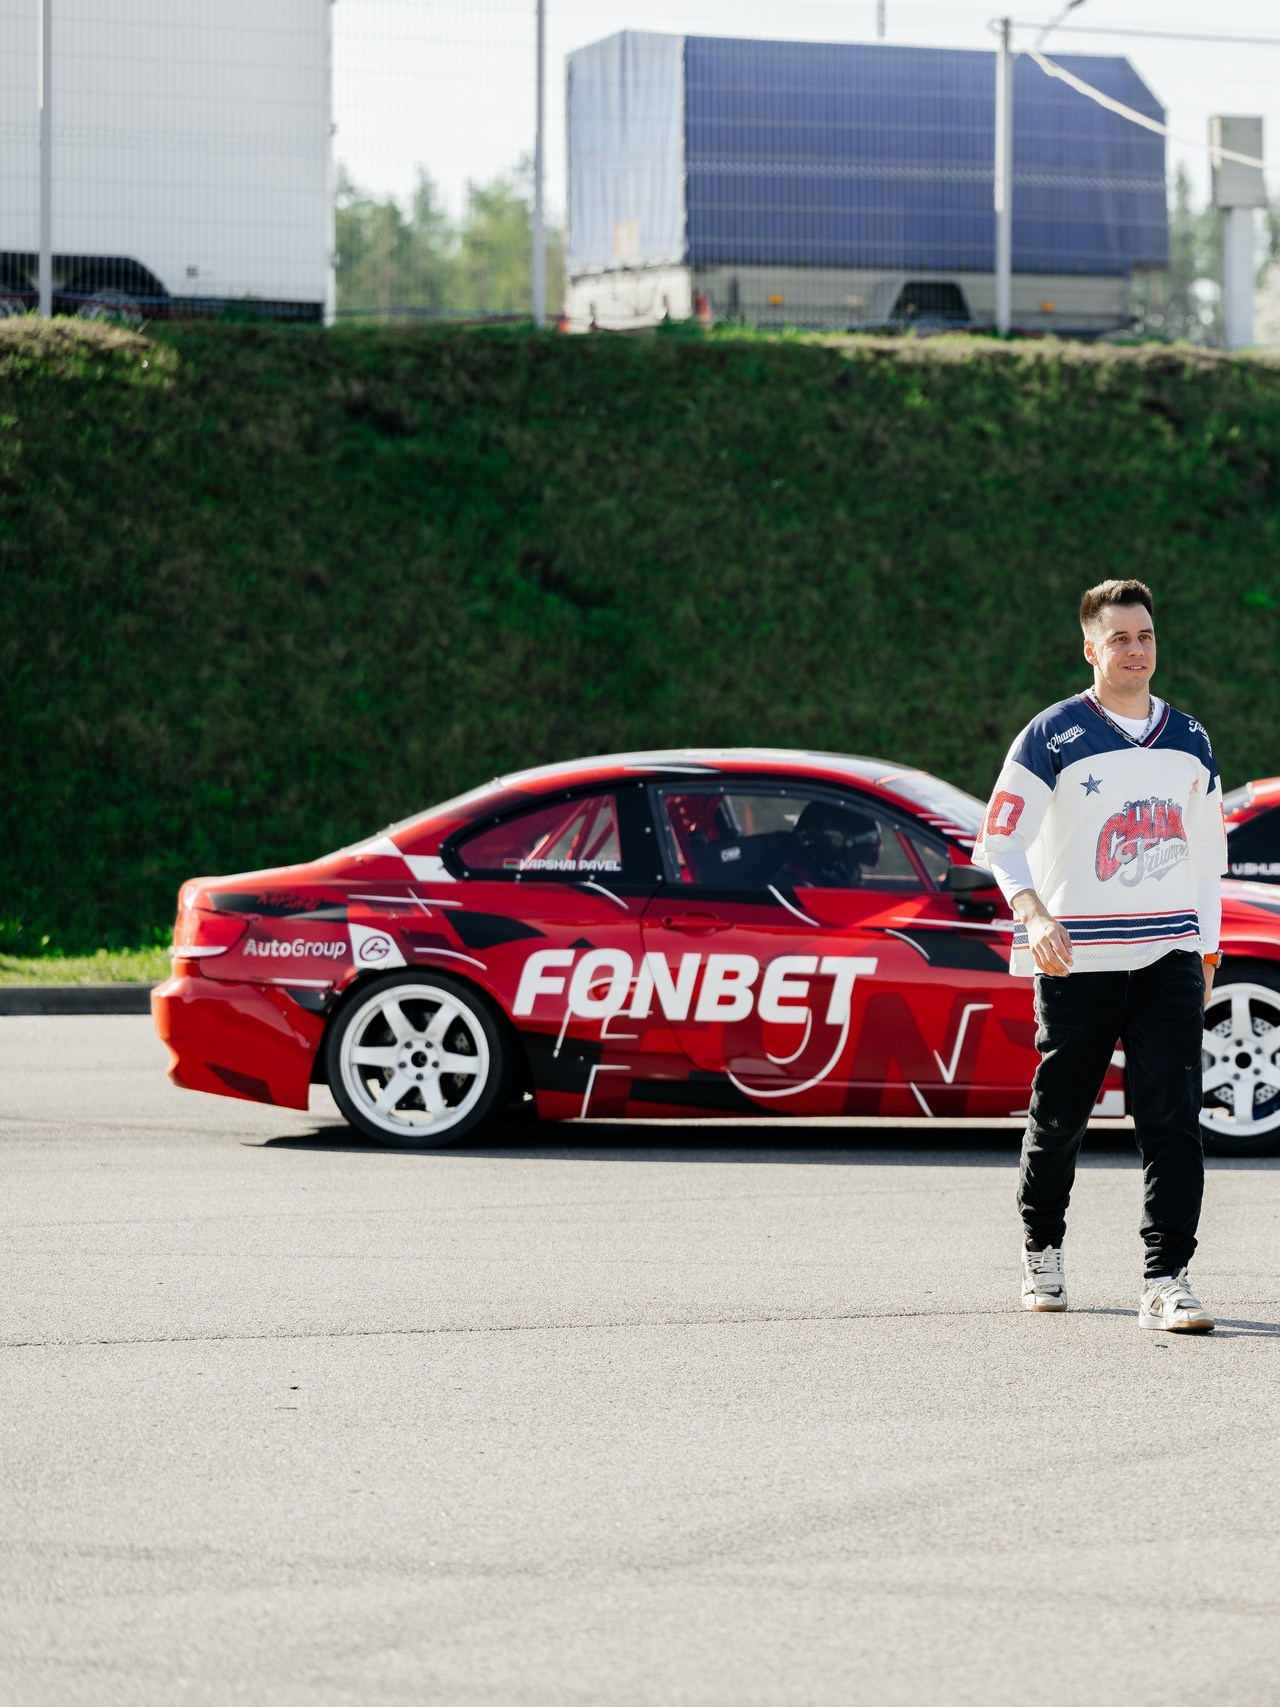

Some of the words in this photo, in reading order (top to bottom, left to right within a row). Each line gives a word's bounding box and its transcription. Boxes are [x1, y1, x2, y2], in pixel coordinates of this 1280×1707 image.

[1047, 724, 1086, 753] Champs
[520, 859, 576, 871] KAPSHAI
[579, 860, 621, 871] PAVEL
[243, 938, 347, 960] AutoGroup
[512, 948, 878, 1024] FONBET
